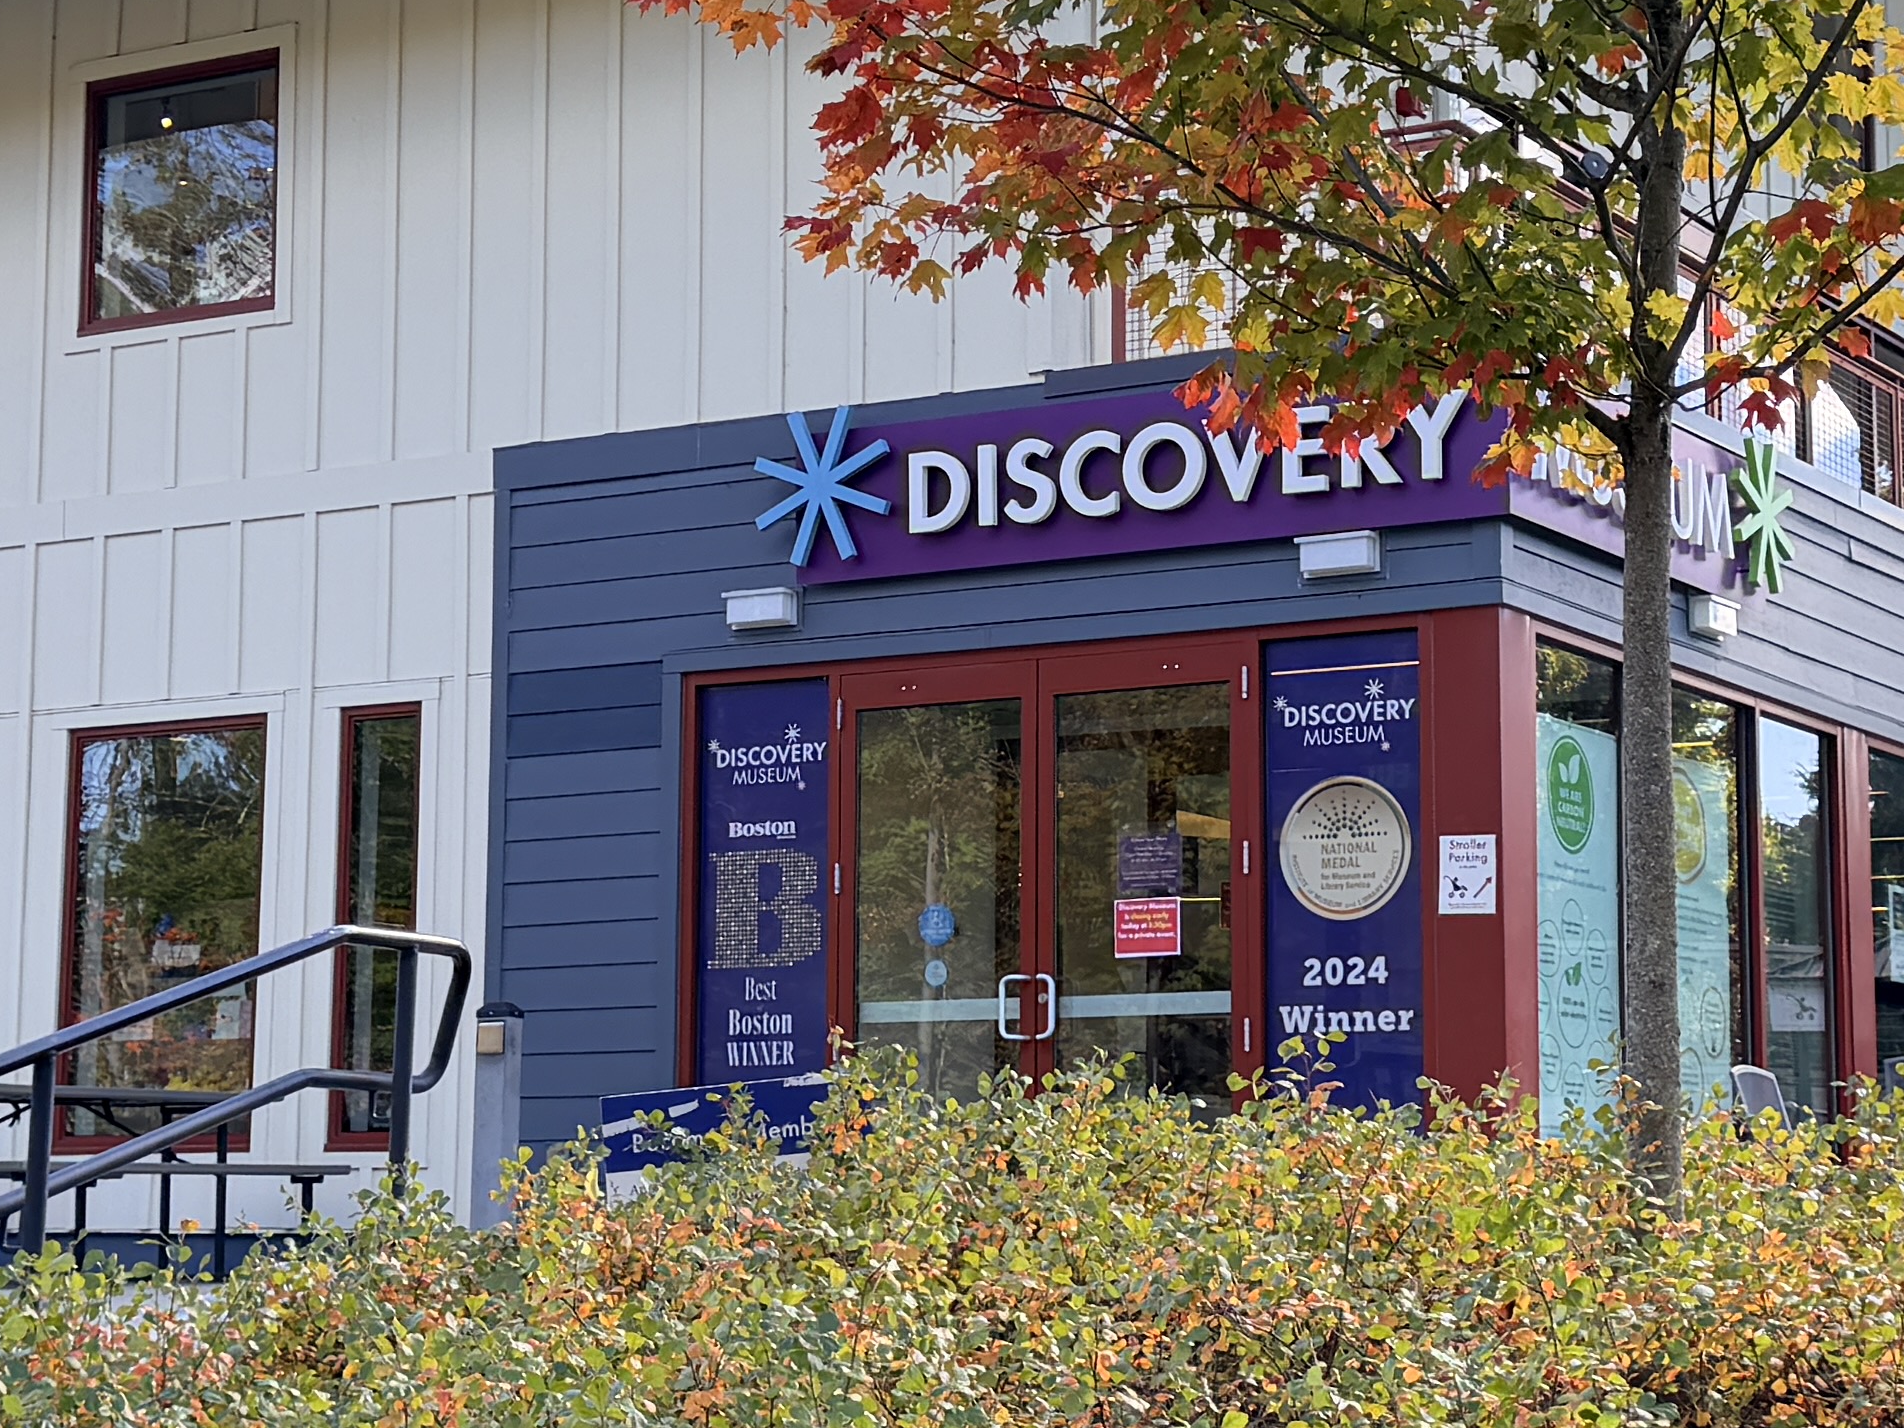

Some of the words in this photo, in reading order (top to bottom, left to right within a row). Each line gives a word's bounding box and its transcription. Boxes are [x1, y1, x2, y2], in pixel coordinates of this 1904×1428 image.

[908, 389, 1468, 534] DISCOVERY
[1284, 698, 1415, 727] DISCOVERY
[1303, 724, 1385, 747] MUSEUM
[716, 742, 827, 768] DISCOVERY
[732, 765, 801, 785] MUSEUM
[728, 820, 796, 838] Boston
[1321, 841, 1377, 855] NATIONAL
[1449, 838, 1487, 850] Stroller
[1321, 856, 1361, 869] MEDAL
[1448, 852, 1488, 865] Parking
[1363, 871, 1376, 880] and
[707, 849, 821, 969] B
[1303, 956, 1389, 986] 2024
[745, 976, 777, 1001] Best
[728, 1009, 793, 1036] Boston
[1279, 1005, 1414, 1034] Winner
[727, 1040, 794, 1066] WINNER
